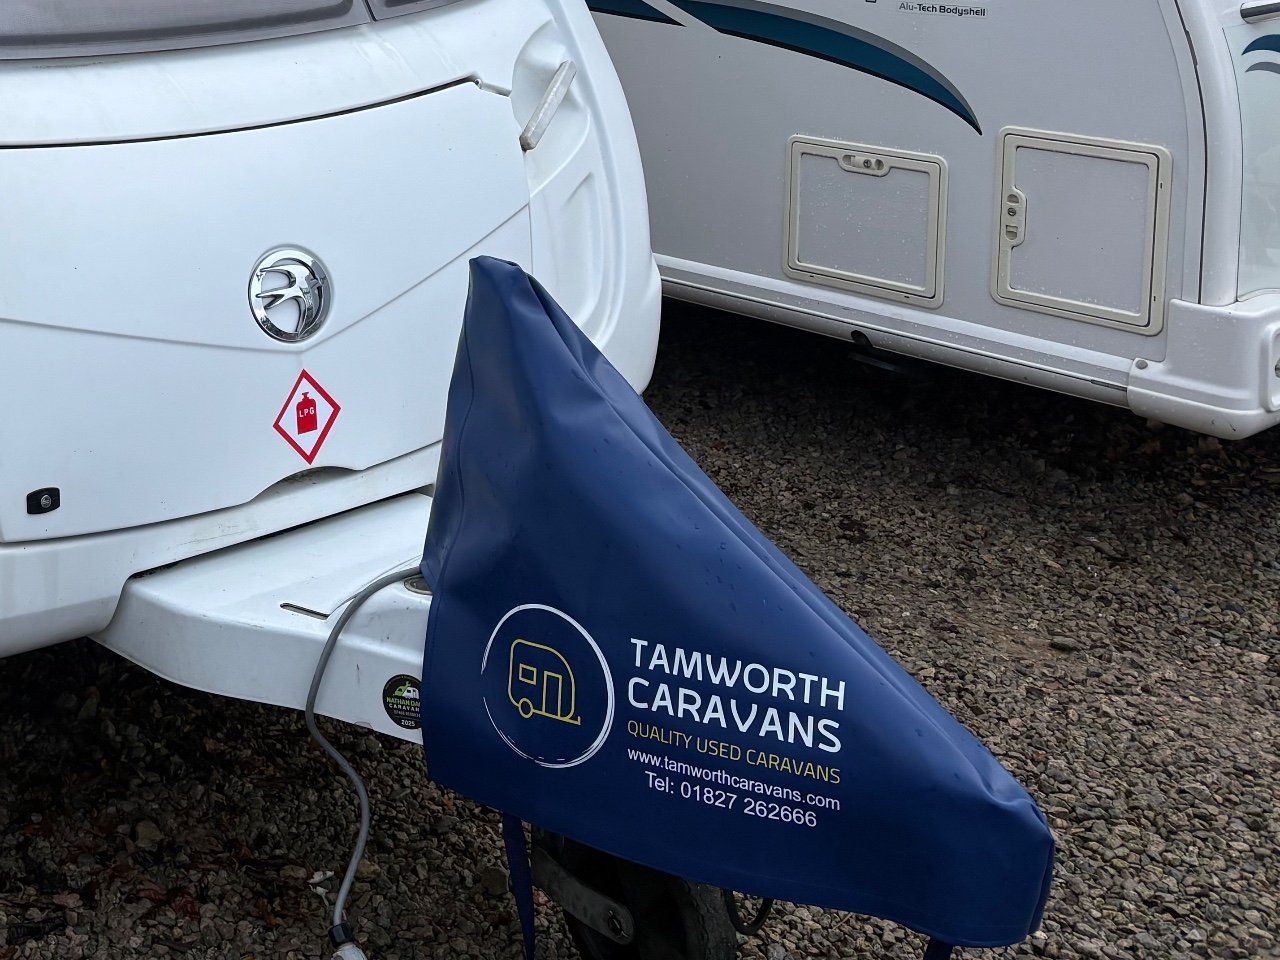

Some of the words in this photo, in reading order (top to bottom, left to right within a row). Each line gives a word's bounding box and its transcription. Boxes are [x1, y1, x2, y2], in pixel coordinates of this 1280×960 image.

[898, 1, 937, 13] Alu-Tech
[939, 5, 986, 17] Bodyshell
[299, 406, 315, 418] LPG
[386, 696, 410, 706] NATHAN
[630, 637, 846, 711] TAMWORTH
[401, 719, 416, 727] 2025
[627, 676, 842, 754] CARAVANS
[627, 720, 693, 749] QUALITY
[696, 736, 741, 761] USED
[746, 749, 841, 784] CARAVANS
[627, 747, 841, 811] www.tamworthcaravans.com
[644, 770, 675, 794] Tel:
[680, 782, 738, 810] 01827
[743, 797, 818, 828] 262666
